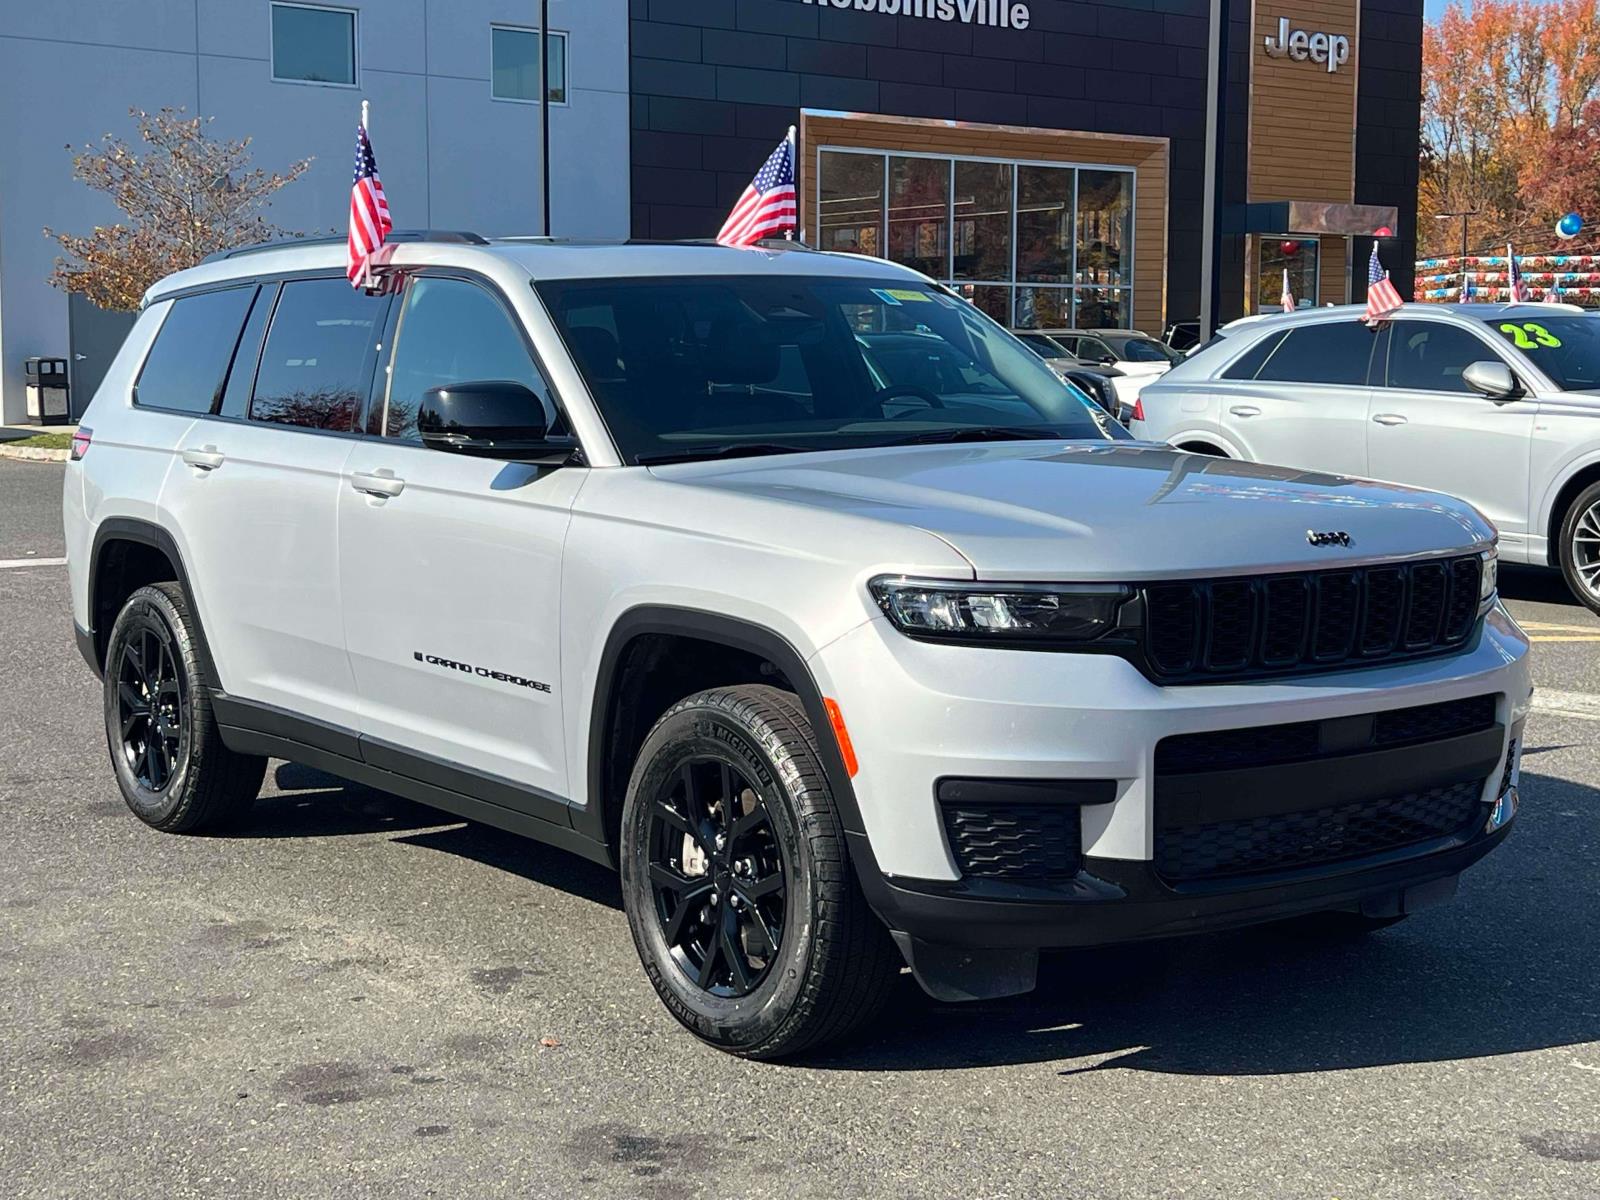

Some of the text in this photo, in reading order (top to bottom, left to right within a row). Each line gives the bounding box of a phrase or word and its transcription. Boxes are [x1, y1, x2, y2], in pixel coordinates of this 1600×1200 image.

[802, 0, 1030, 30] nsville
[1264, 17, 1350, 73] Jeep
[1500, 323, 1562, 349] 23
[1306, 530, 1350, 547] Jeep
[426, 655, 552, 693] GRAND CHEROKEE
[716, 726, 770, 786] MICHELIN
